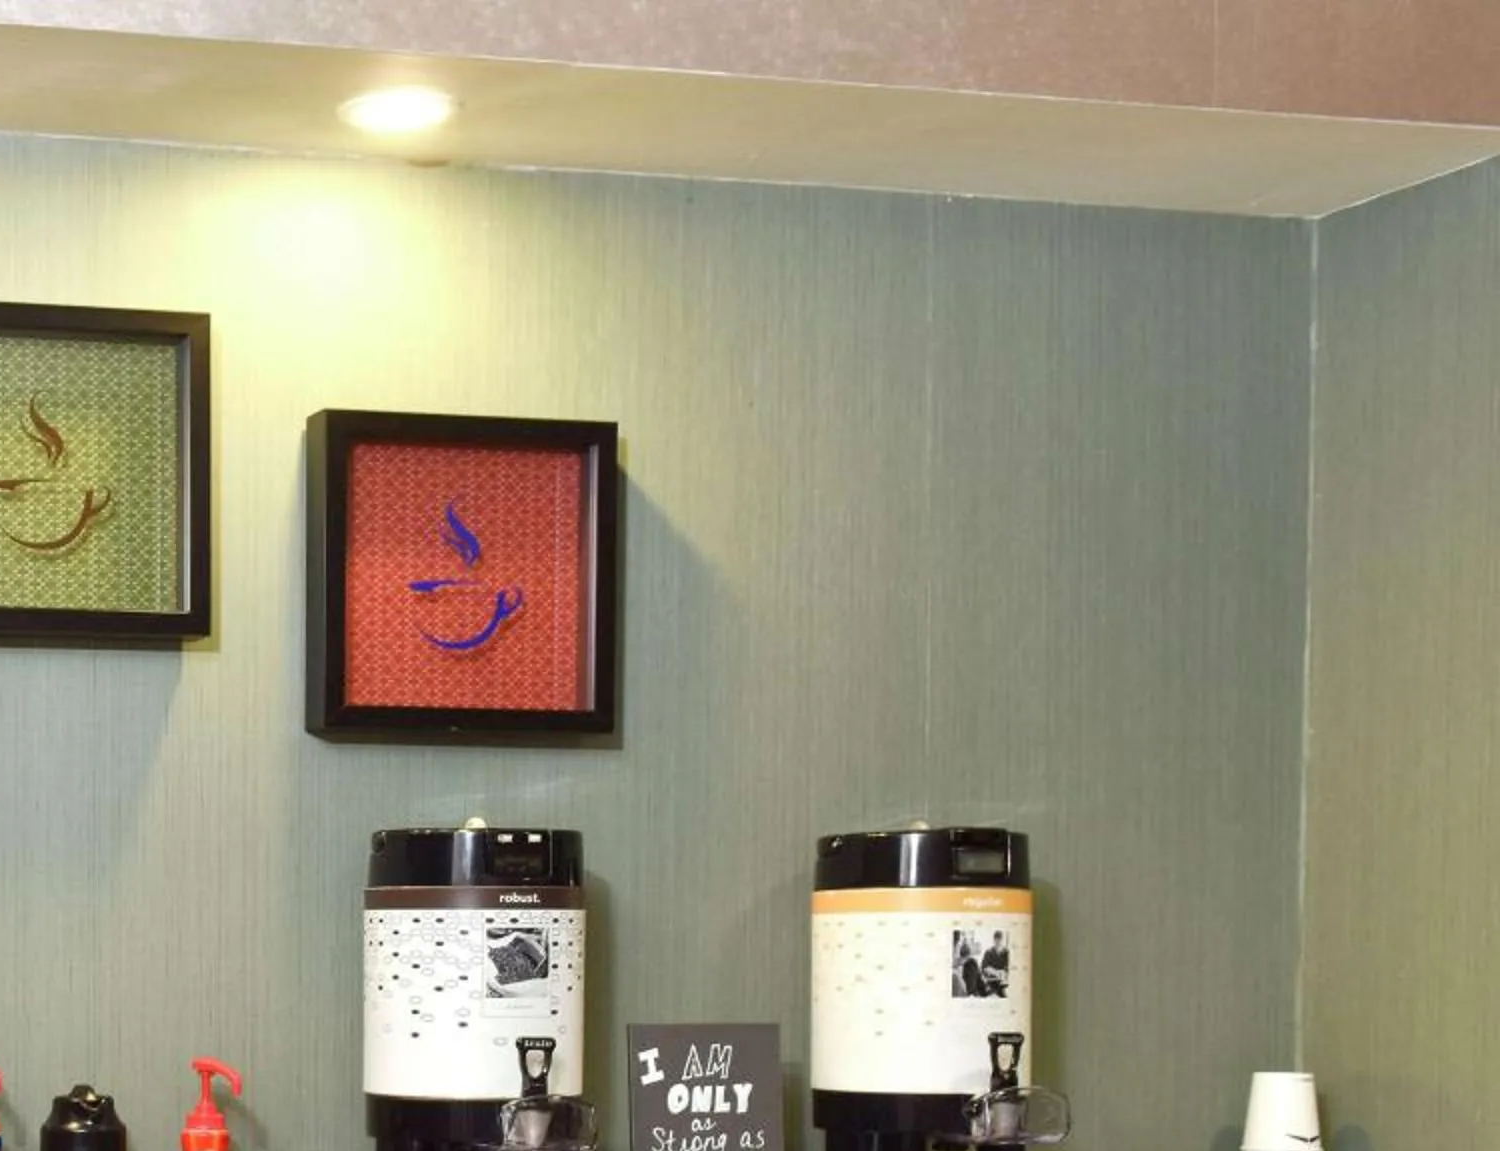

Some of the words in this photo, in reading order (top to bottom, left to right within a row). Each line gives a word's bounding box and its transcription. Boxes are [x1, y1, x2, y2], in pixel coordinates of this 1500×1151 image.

[499, 892, 541, 903] robust.
[638, 1047, 665, 1086] I
[681, 1043, 733, 1080] AM
[667, 1083, 753, 1114] ONLY
[691, 1117, 717, 1132] as
[740, 1130, 765, 1149] as
